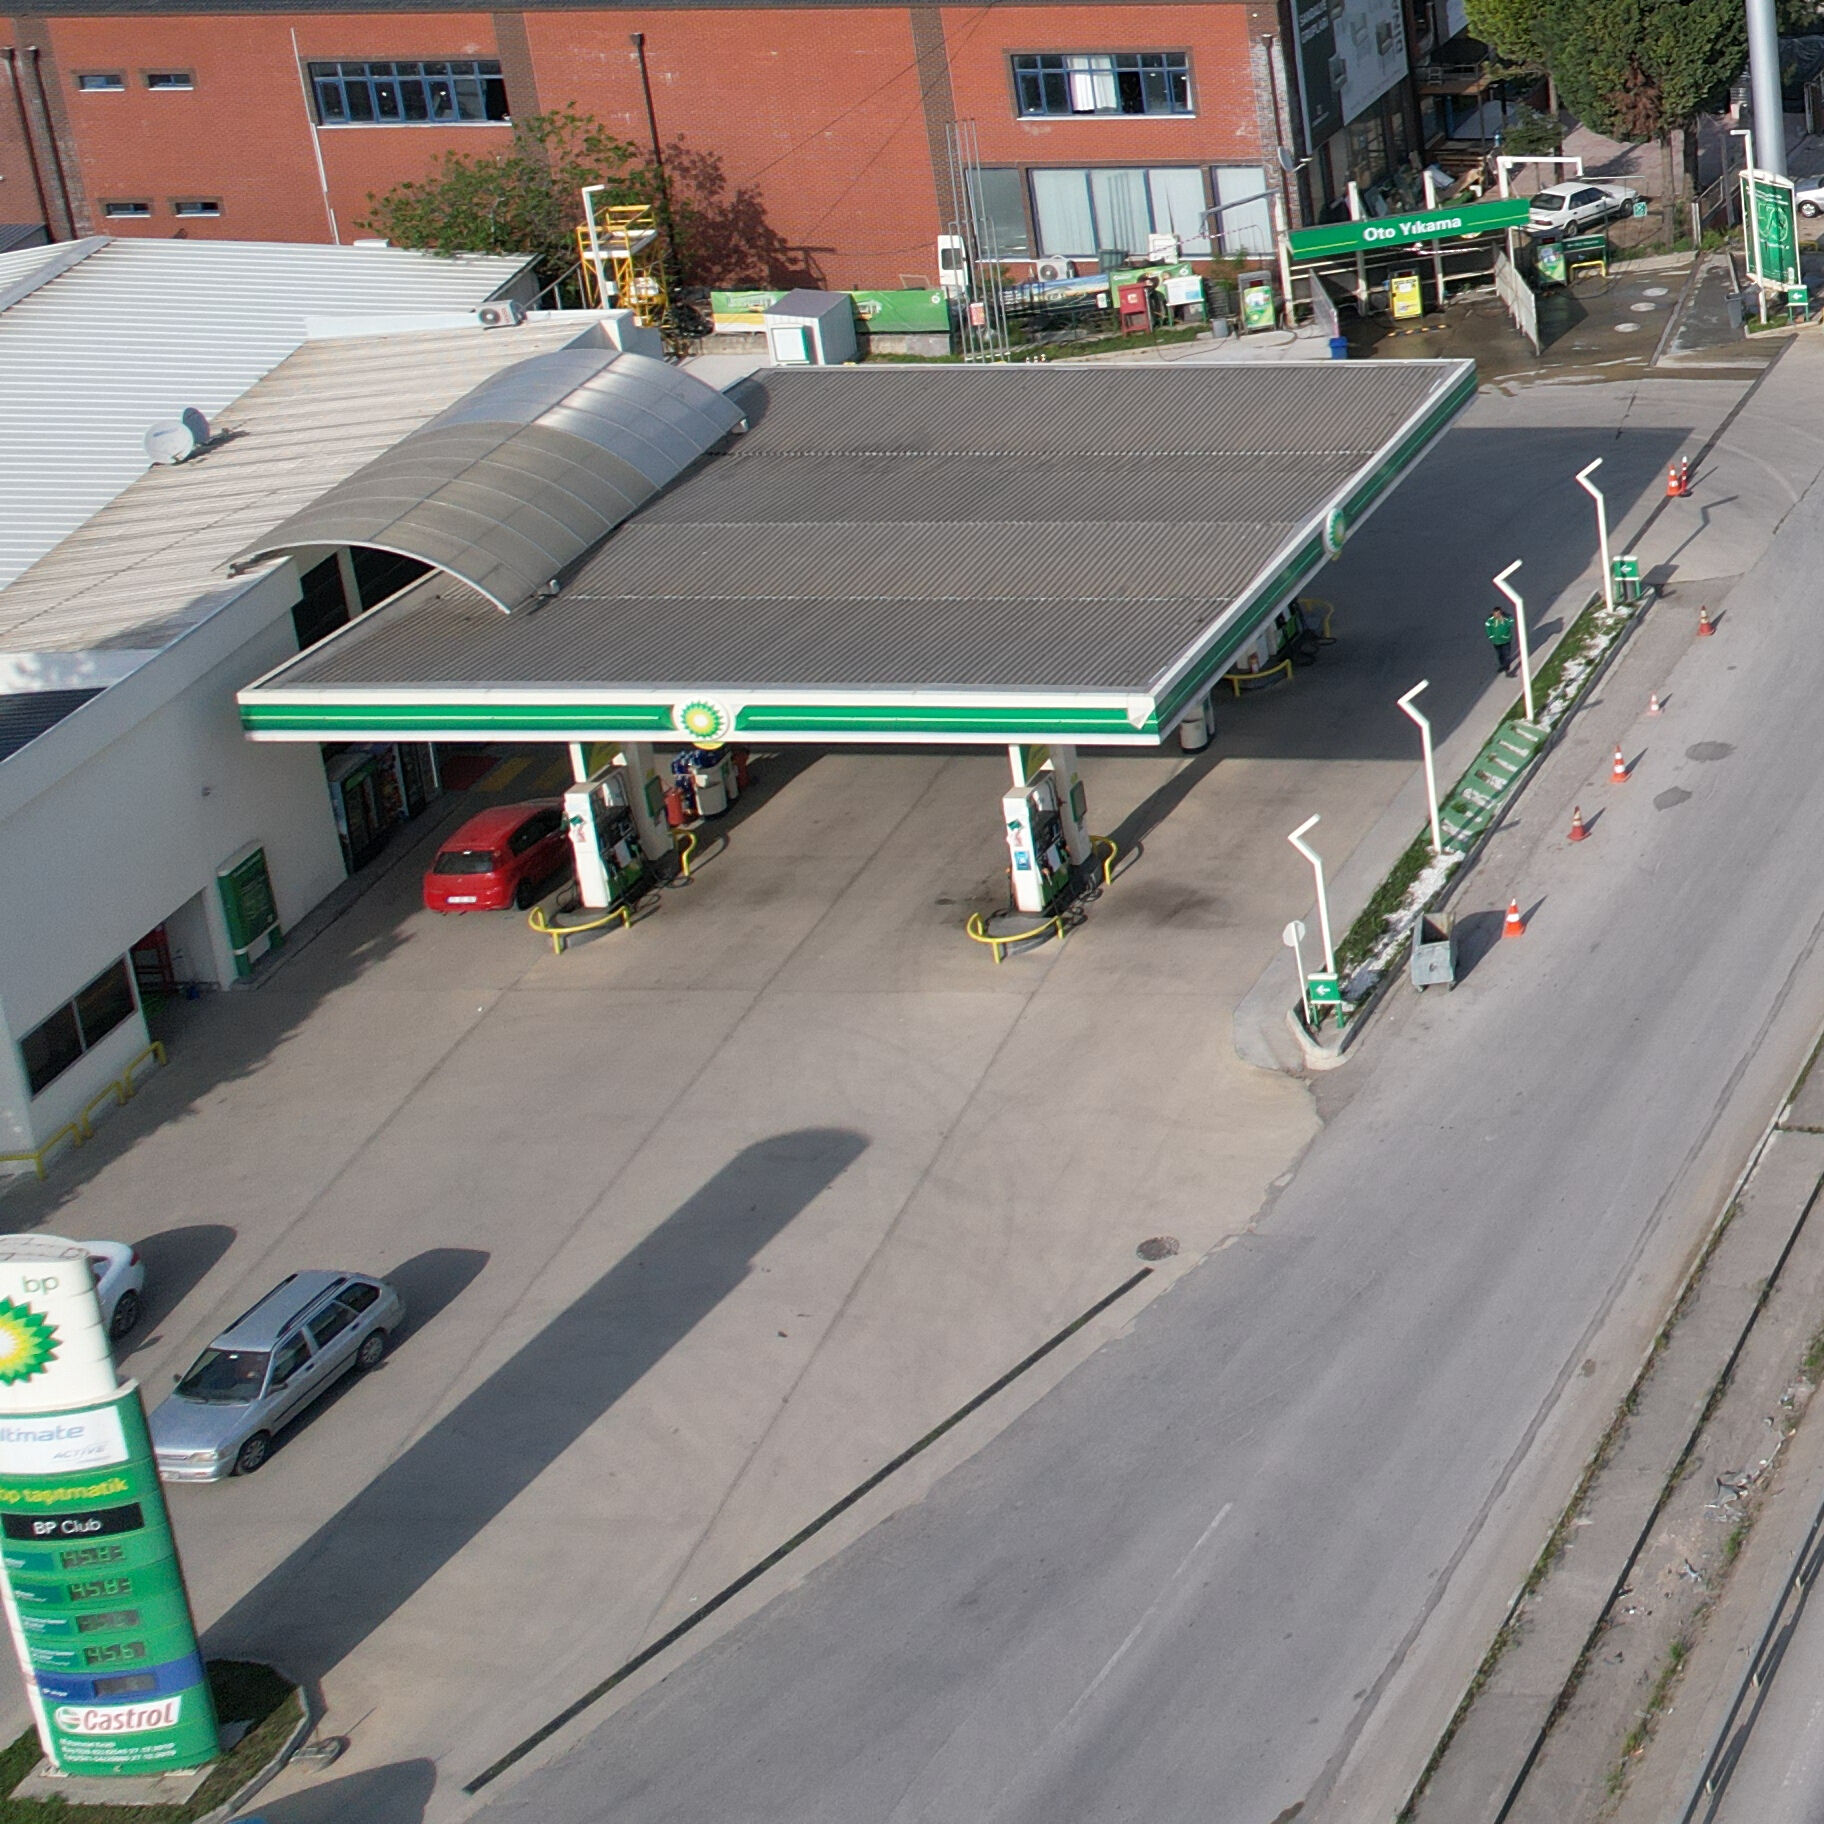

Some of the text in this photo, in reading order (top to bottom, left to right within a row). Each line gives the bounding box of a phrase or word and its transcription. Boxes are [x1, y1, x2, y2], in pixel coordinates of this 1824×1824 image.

[1363, 217, 1462, 241] Oto Yıkama
[22, 1275, 59, 1295] bp
[33, 1518, 102, 1535] BP Club
[83, 1702, 174, 1731] Castrol
